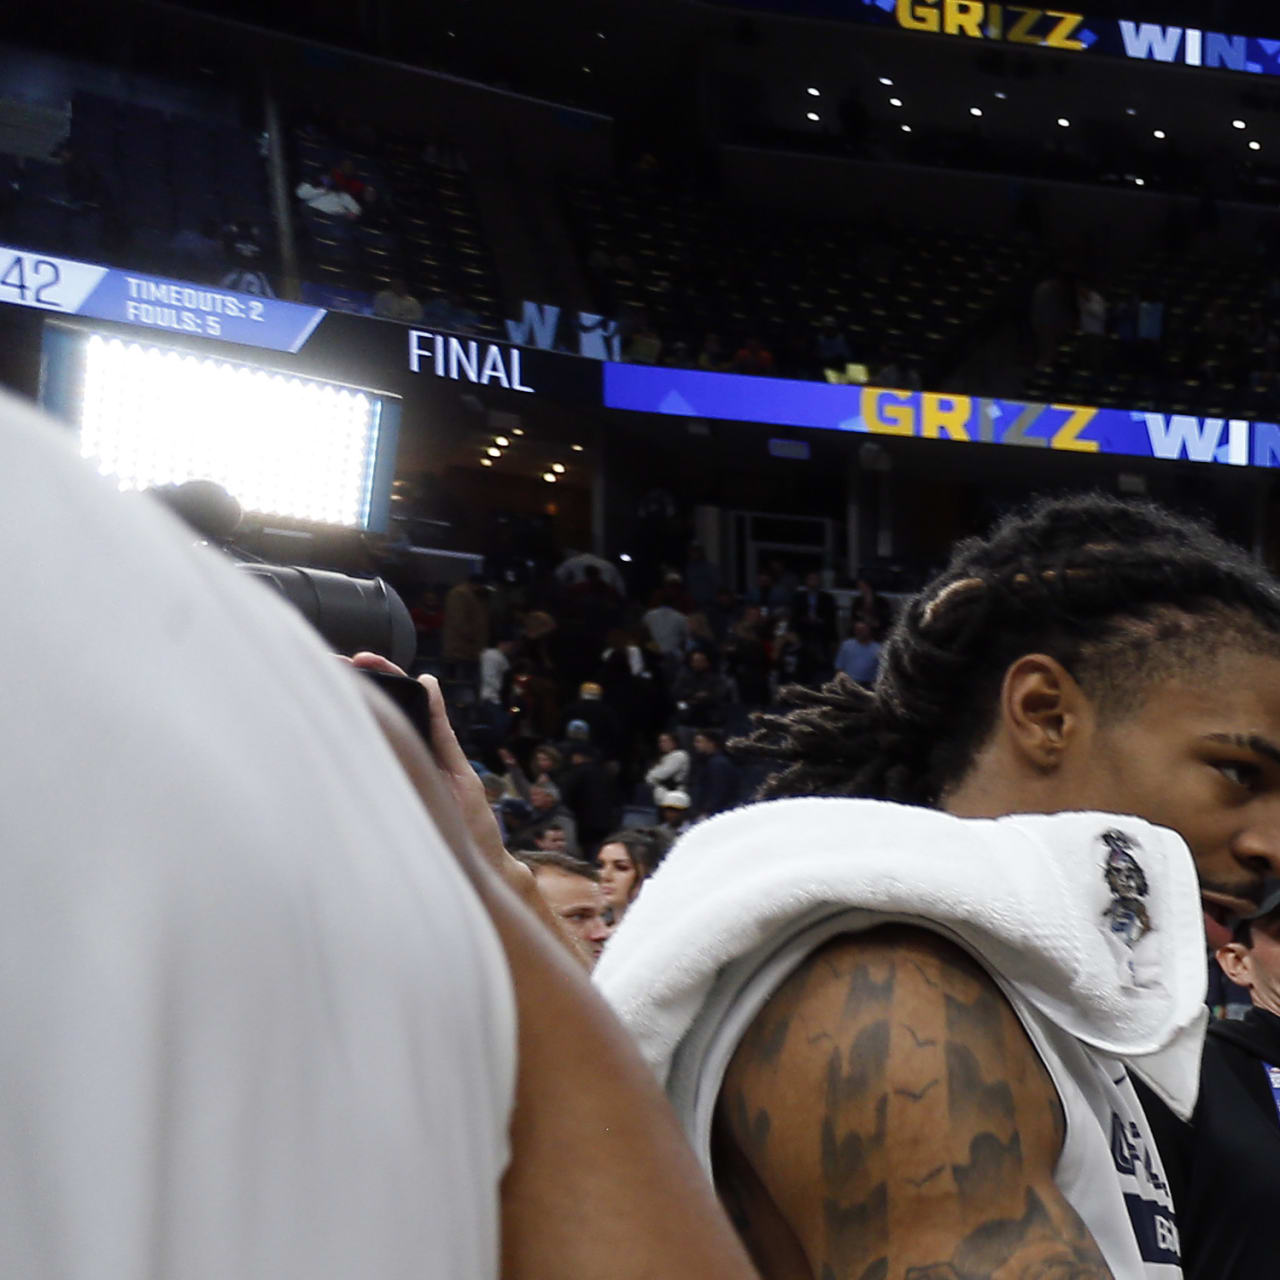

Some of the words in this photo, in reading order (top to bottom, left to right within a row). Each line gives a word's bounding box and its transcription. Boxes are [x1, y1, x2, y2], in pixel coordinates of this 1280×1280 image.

[1118, 20, 1247, 71] WIN
[125, 276, 246, 318] TIMEOUTS:
[249, 300, 265, 322] 2
[126, 301, 202, 333] FOULS:
[206, 316, 221, 336] 5
[408, 329, 536, 393] FINAL
[860, 386, 1099, 453] GRIZZ
